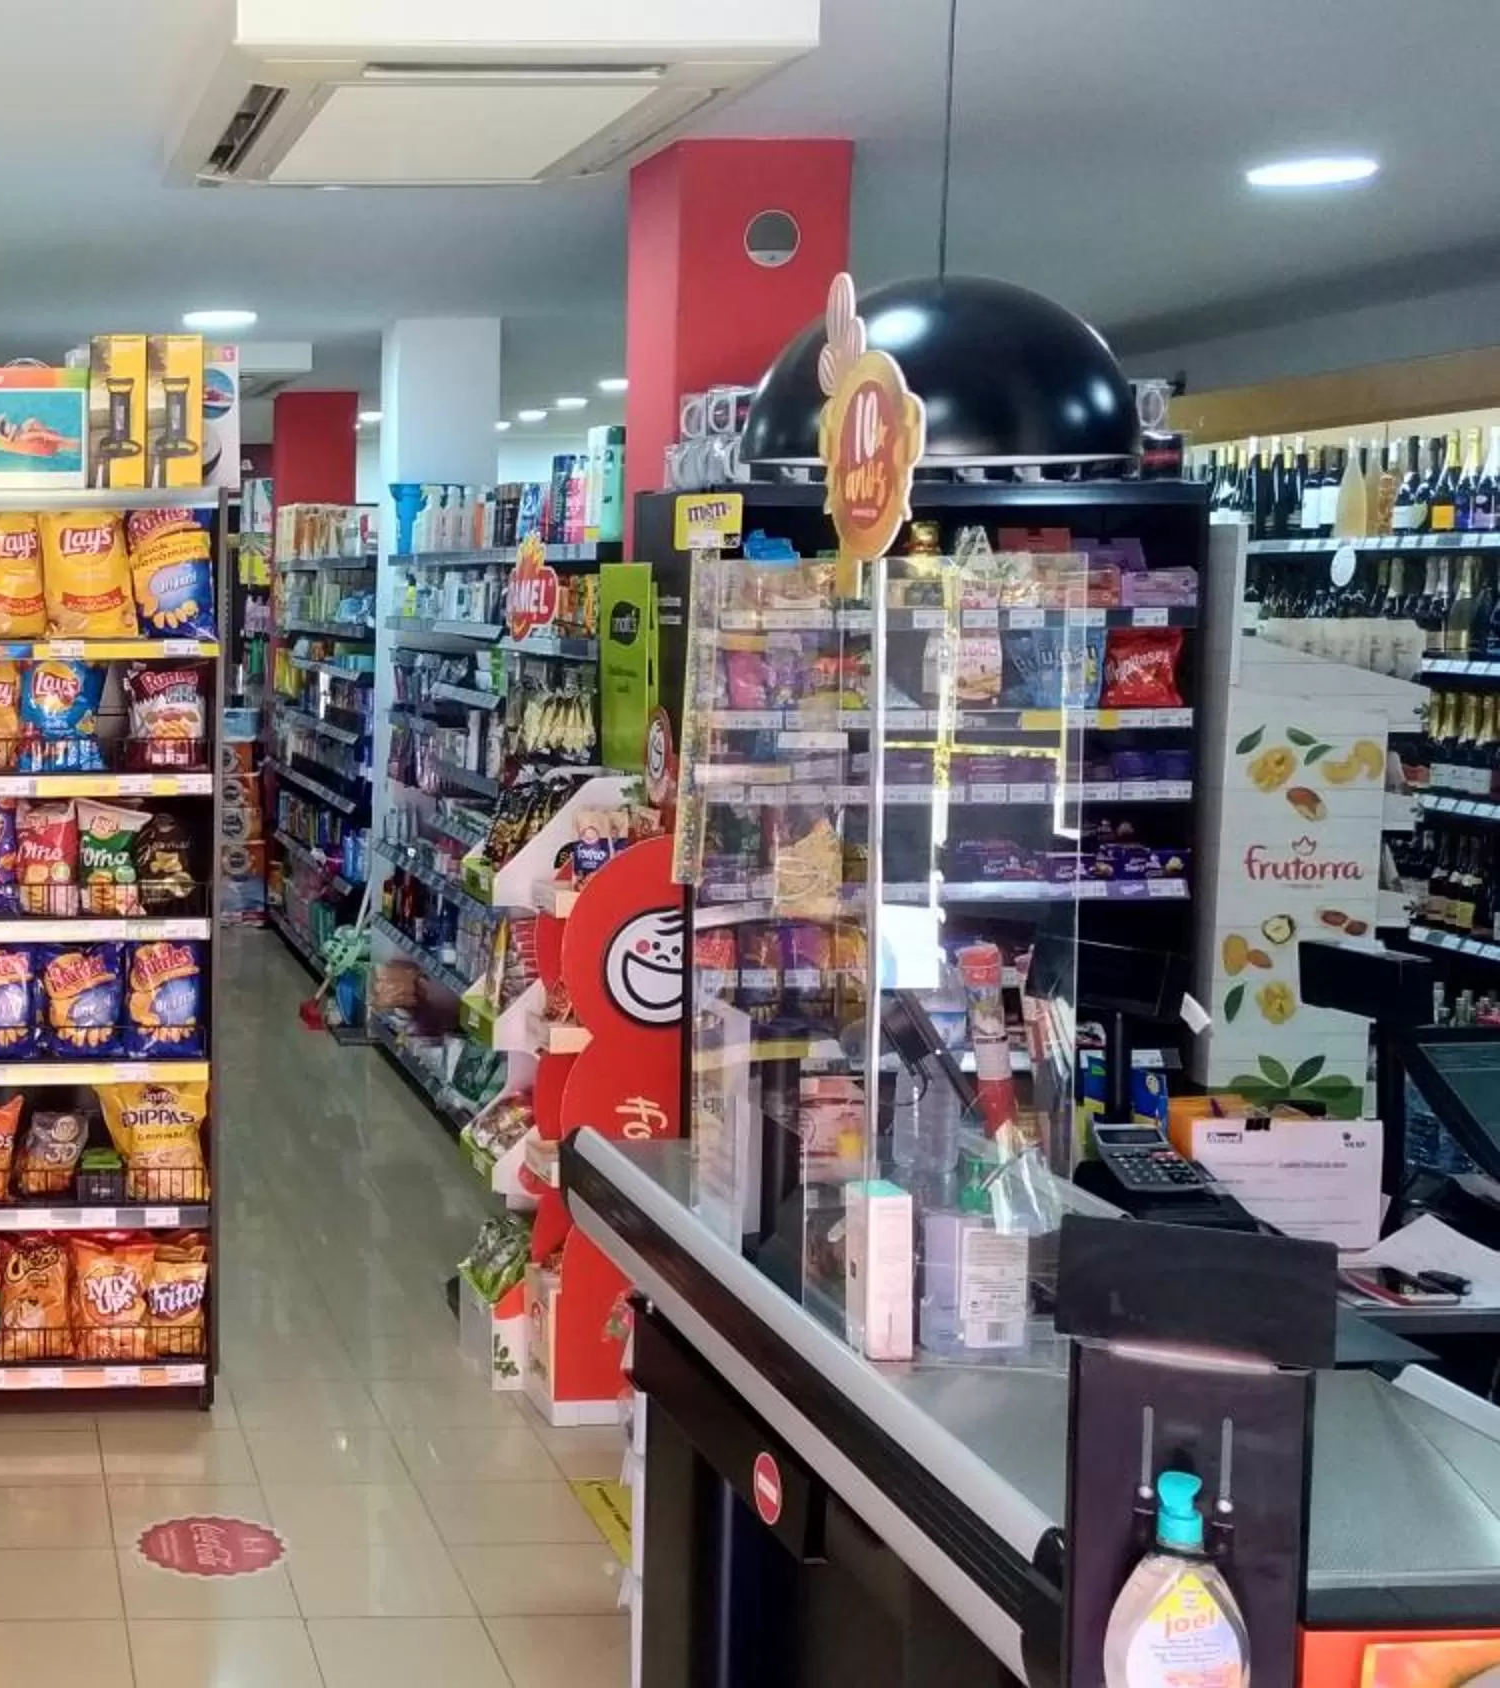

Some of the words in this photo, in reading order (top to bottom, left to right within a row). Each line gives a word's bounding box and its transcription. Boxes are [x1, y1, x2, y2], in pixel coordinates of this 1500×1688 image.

[62, 526, 113, 555] Lay's
[34, 672, 80, 701] Lay's
[1244, 844, 1364, 880] frutorra
